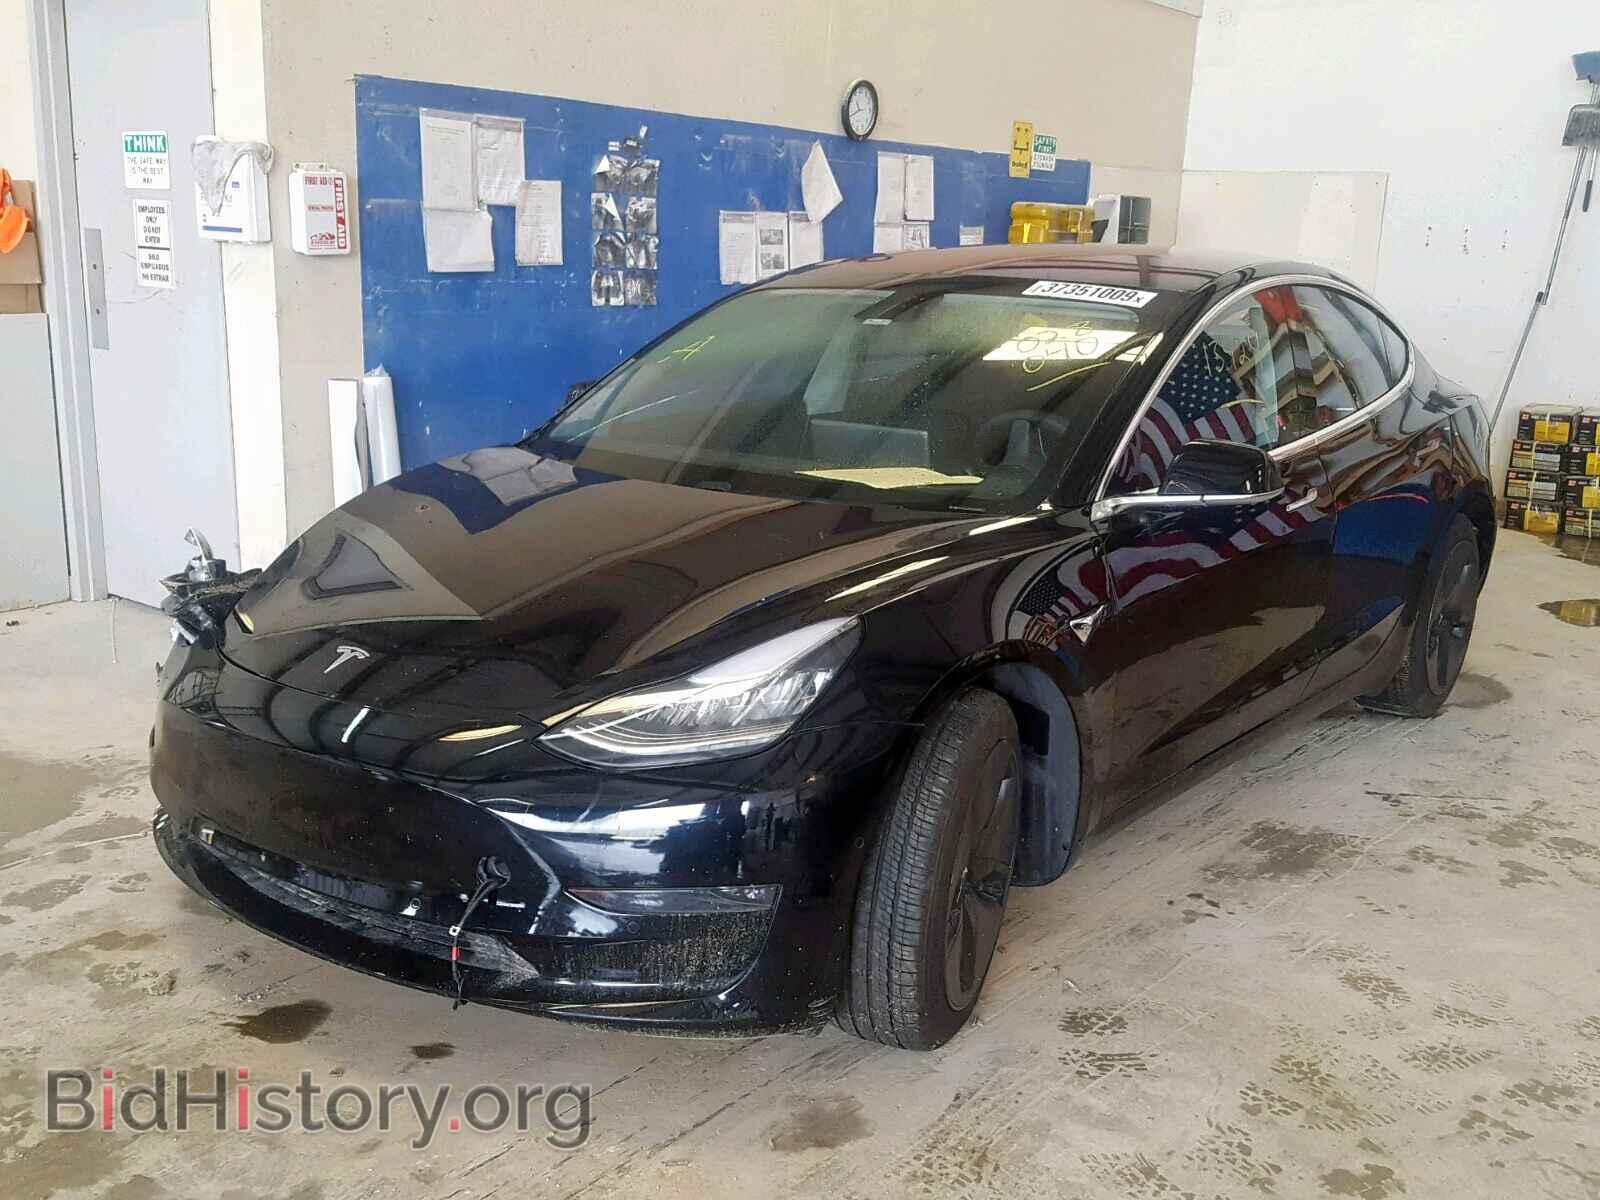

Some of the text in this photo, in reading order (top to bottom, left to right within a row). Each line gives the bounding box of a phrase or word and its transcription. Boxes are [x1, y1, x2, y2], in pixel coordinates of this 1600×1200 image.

[125, 135, 165, 152] THINK
[140, 157, 153, 165] SAFE
[149, 167, 163, 175] BEST
[305, 176, 328, 185] FIRST AID
[138, 205, 165, 214] EMPLOYEES
[335, 178, 346, 248] FIRST AID
[145, 235, 160, 243] ENTER
